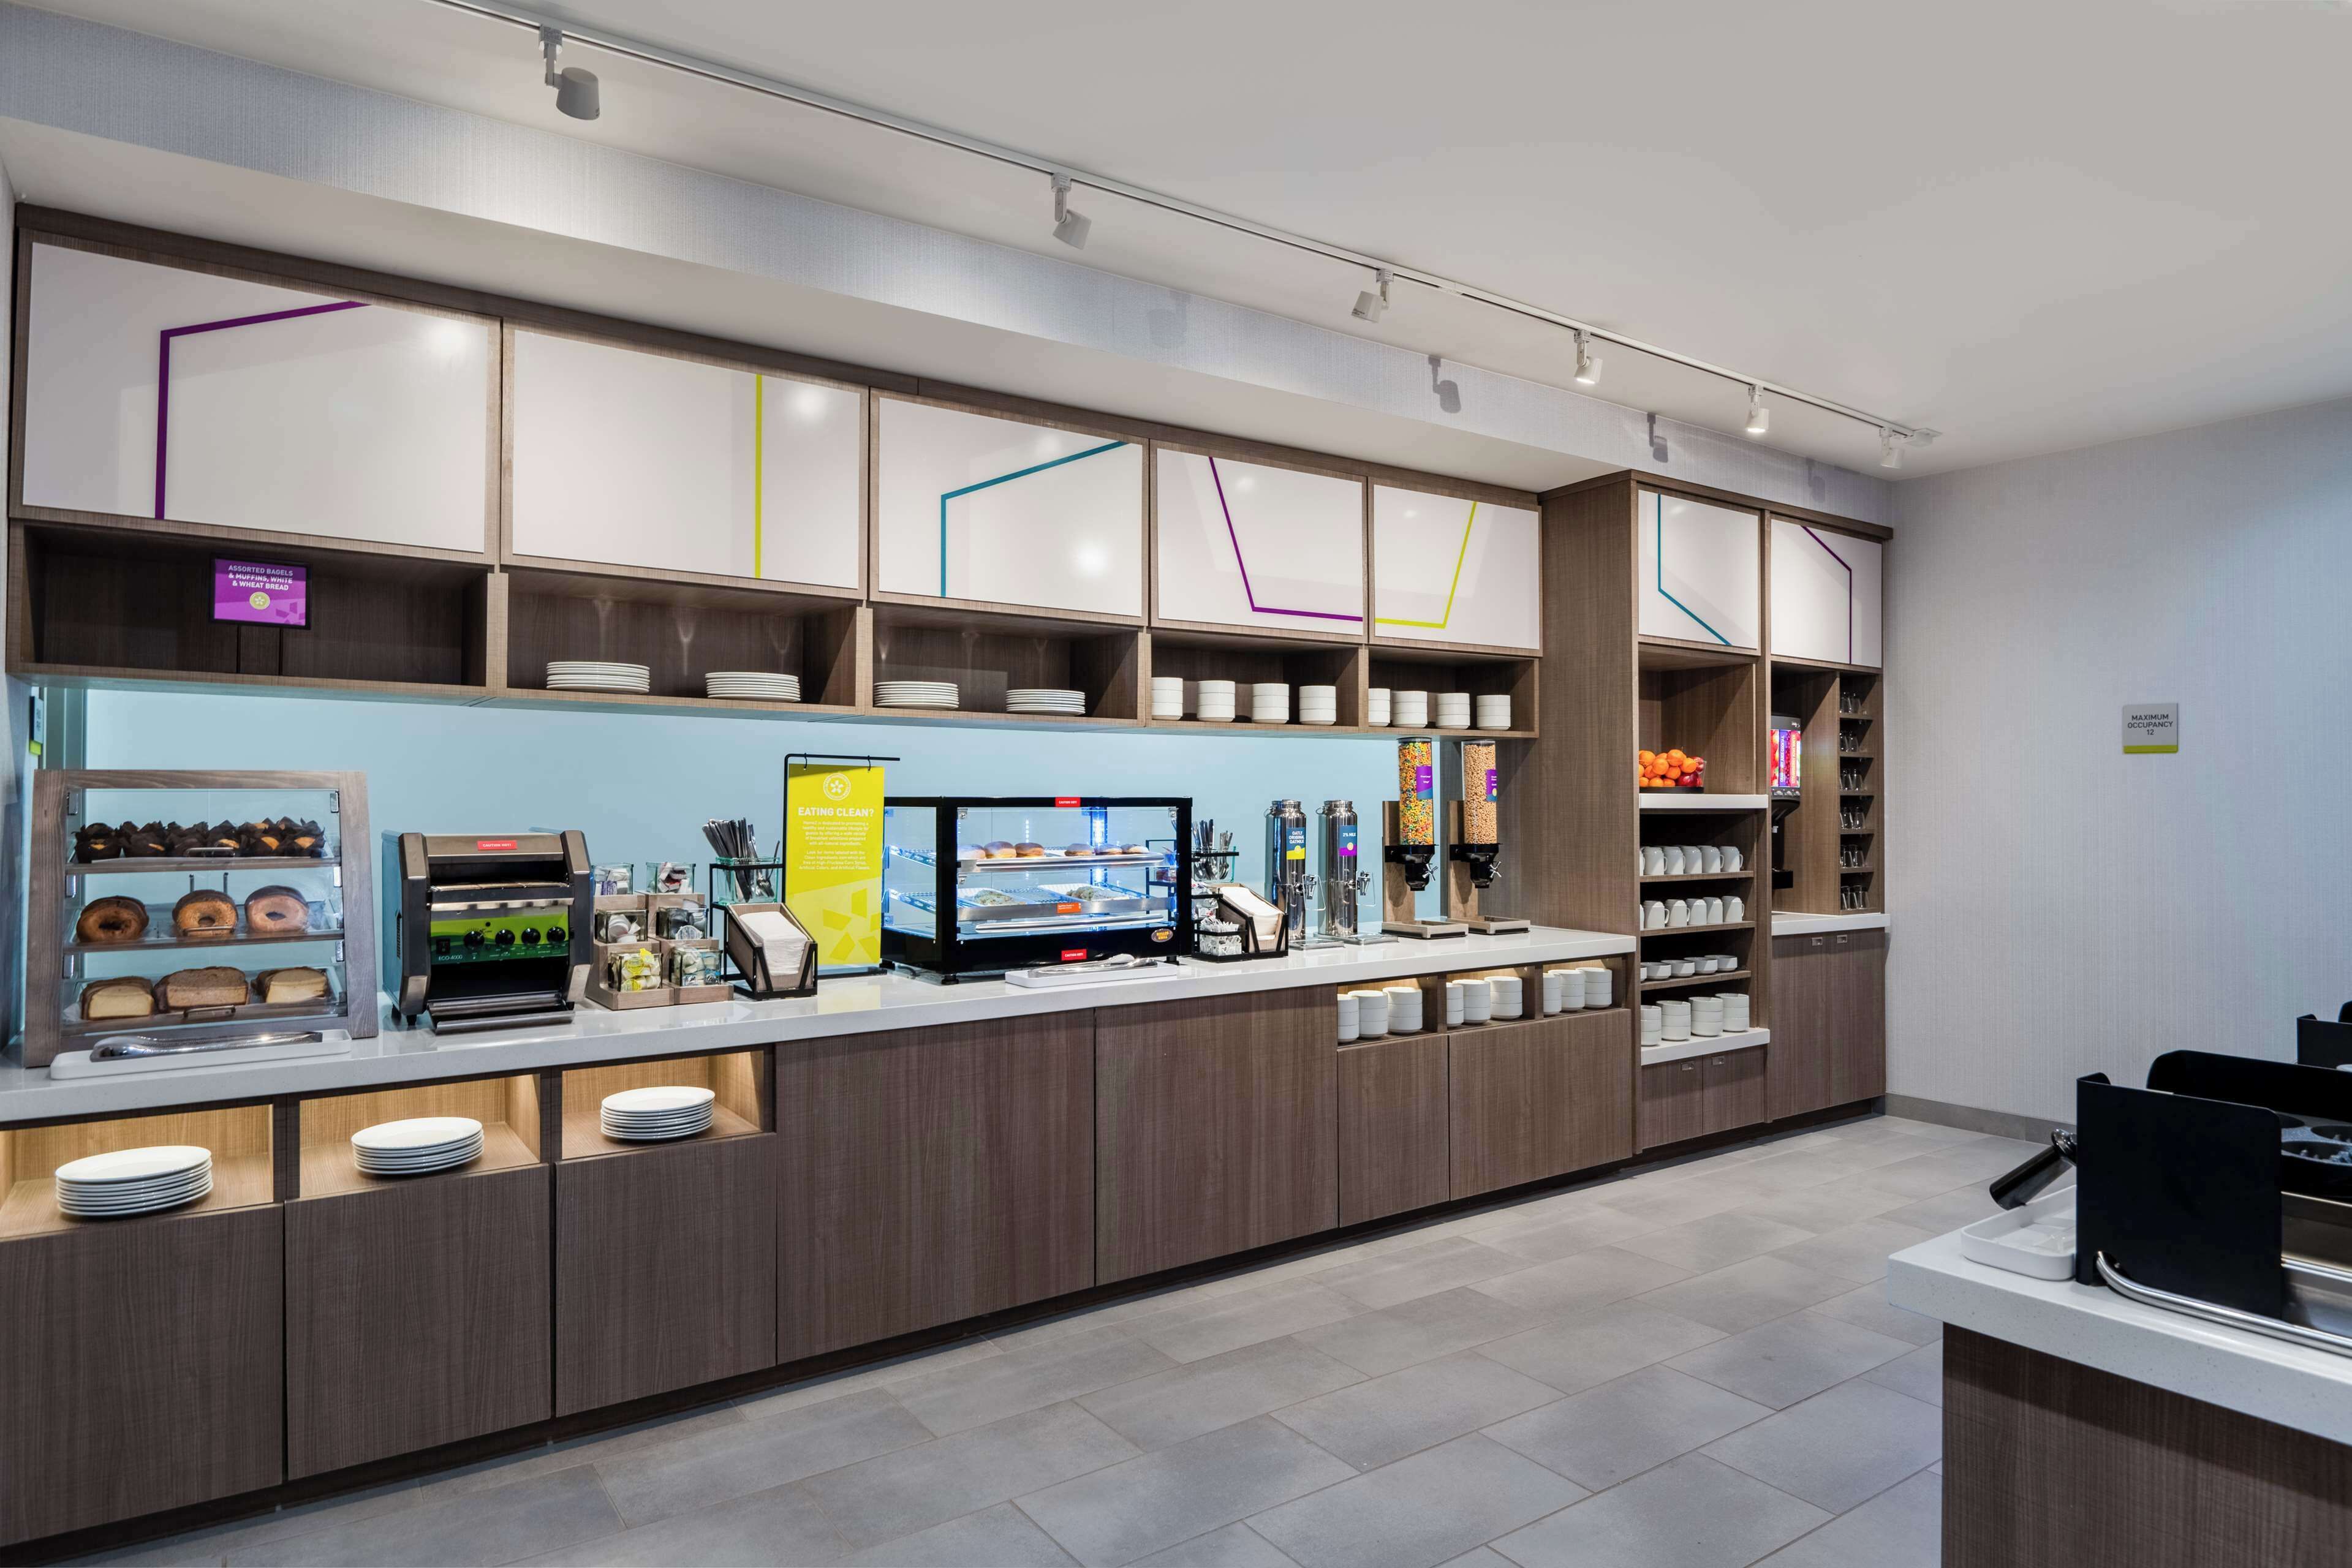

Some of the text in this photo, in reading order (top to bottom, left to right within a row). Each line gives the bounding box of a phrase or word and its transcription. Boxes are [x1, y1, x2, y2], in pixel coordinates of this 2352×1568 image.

[229, 565, 265, 574] ASSORTED
[236, 573, 269, 582] MUFFINS,
[798, 807, 874, 817] EATING CLEAN?
